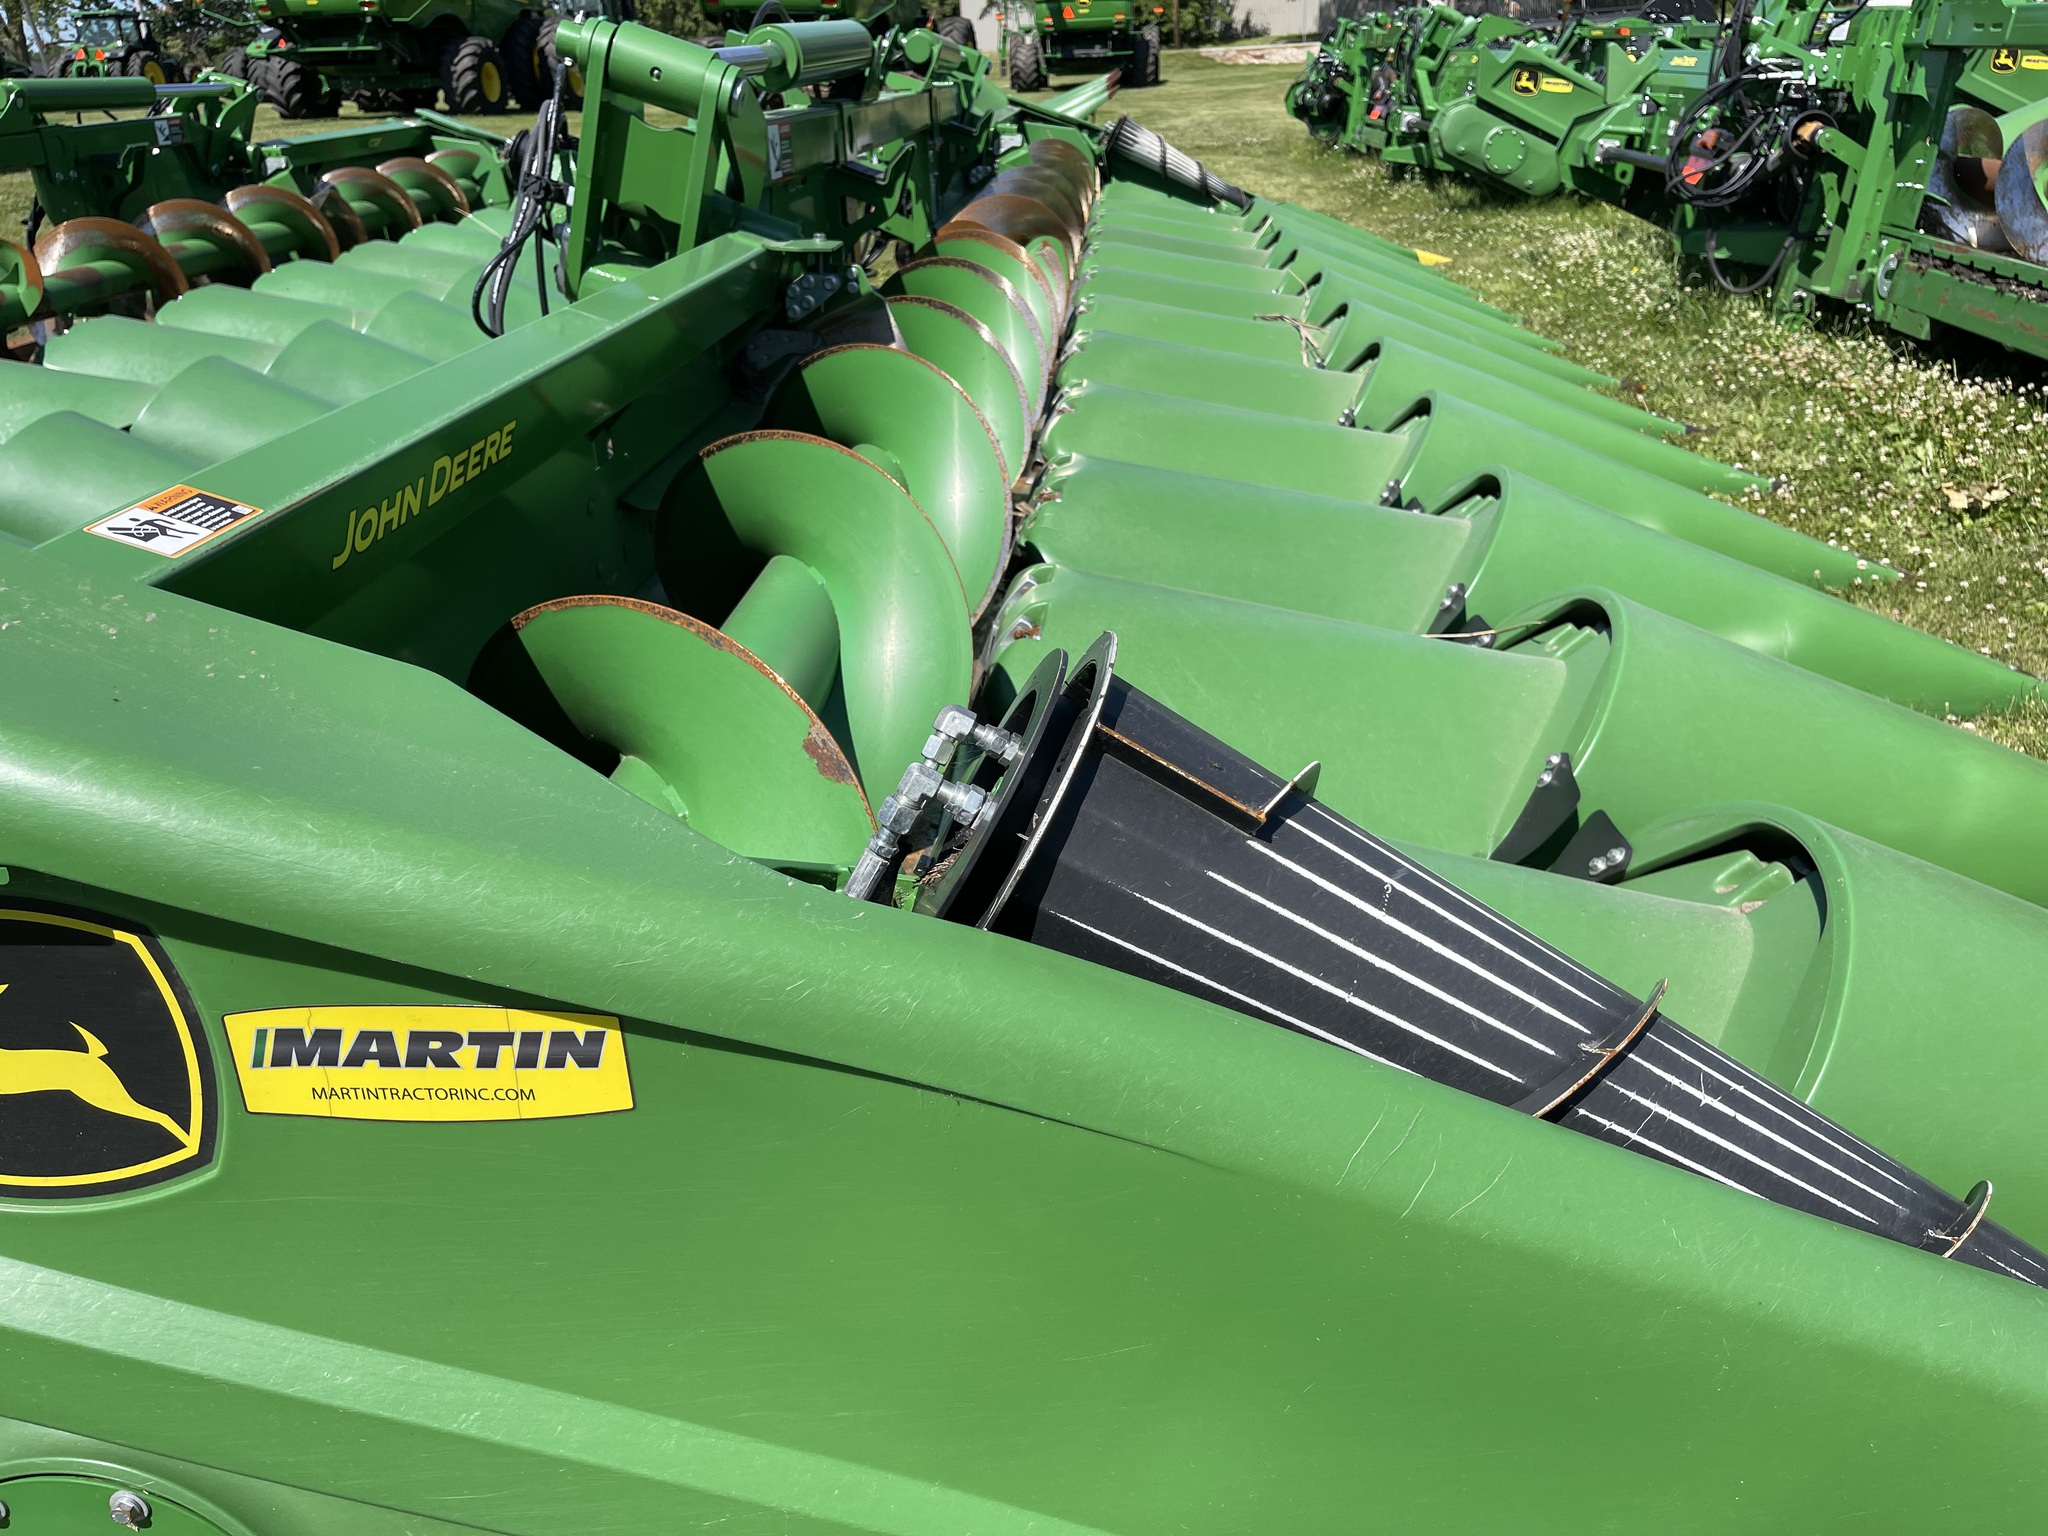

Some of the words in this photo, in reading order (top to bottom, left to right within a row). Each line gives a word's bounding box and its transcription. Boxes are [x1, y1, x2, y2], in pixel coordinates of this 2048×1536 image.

[332, 476, 425, 571] JOHN
[427, 420, 517, 508] DEERE
[269, 1028, 606, 1070] MARTIN
[311, 1086, 537, 1102] MARTINTRACTORINC.COM
